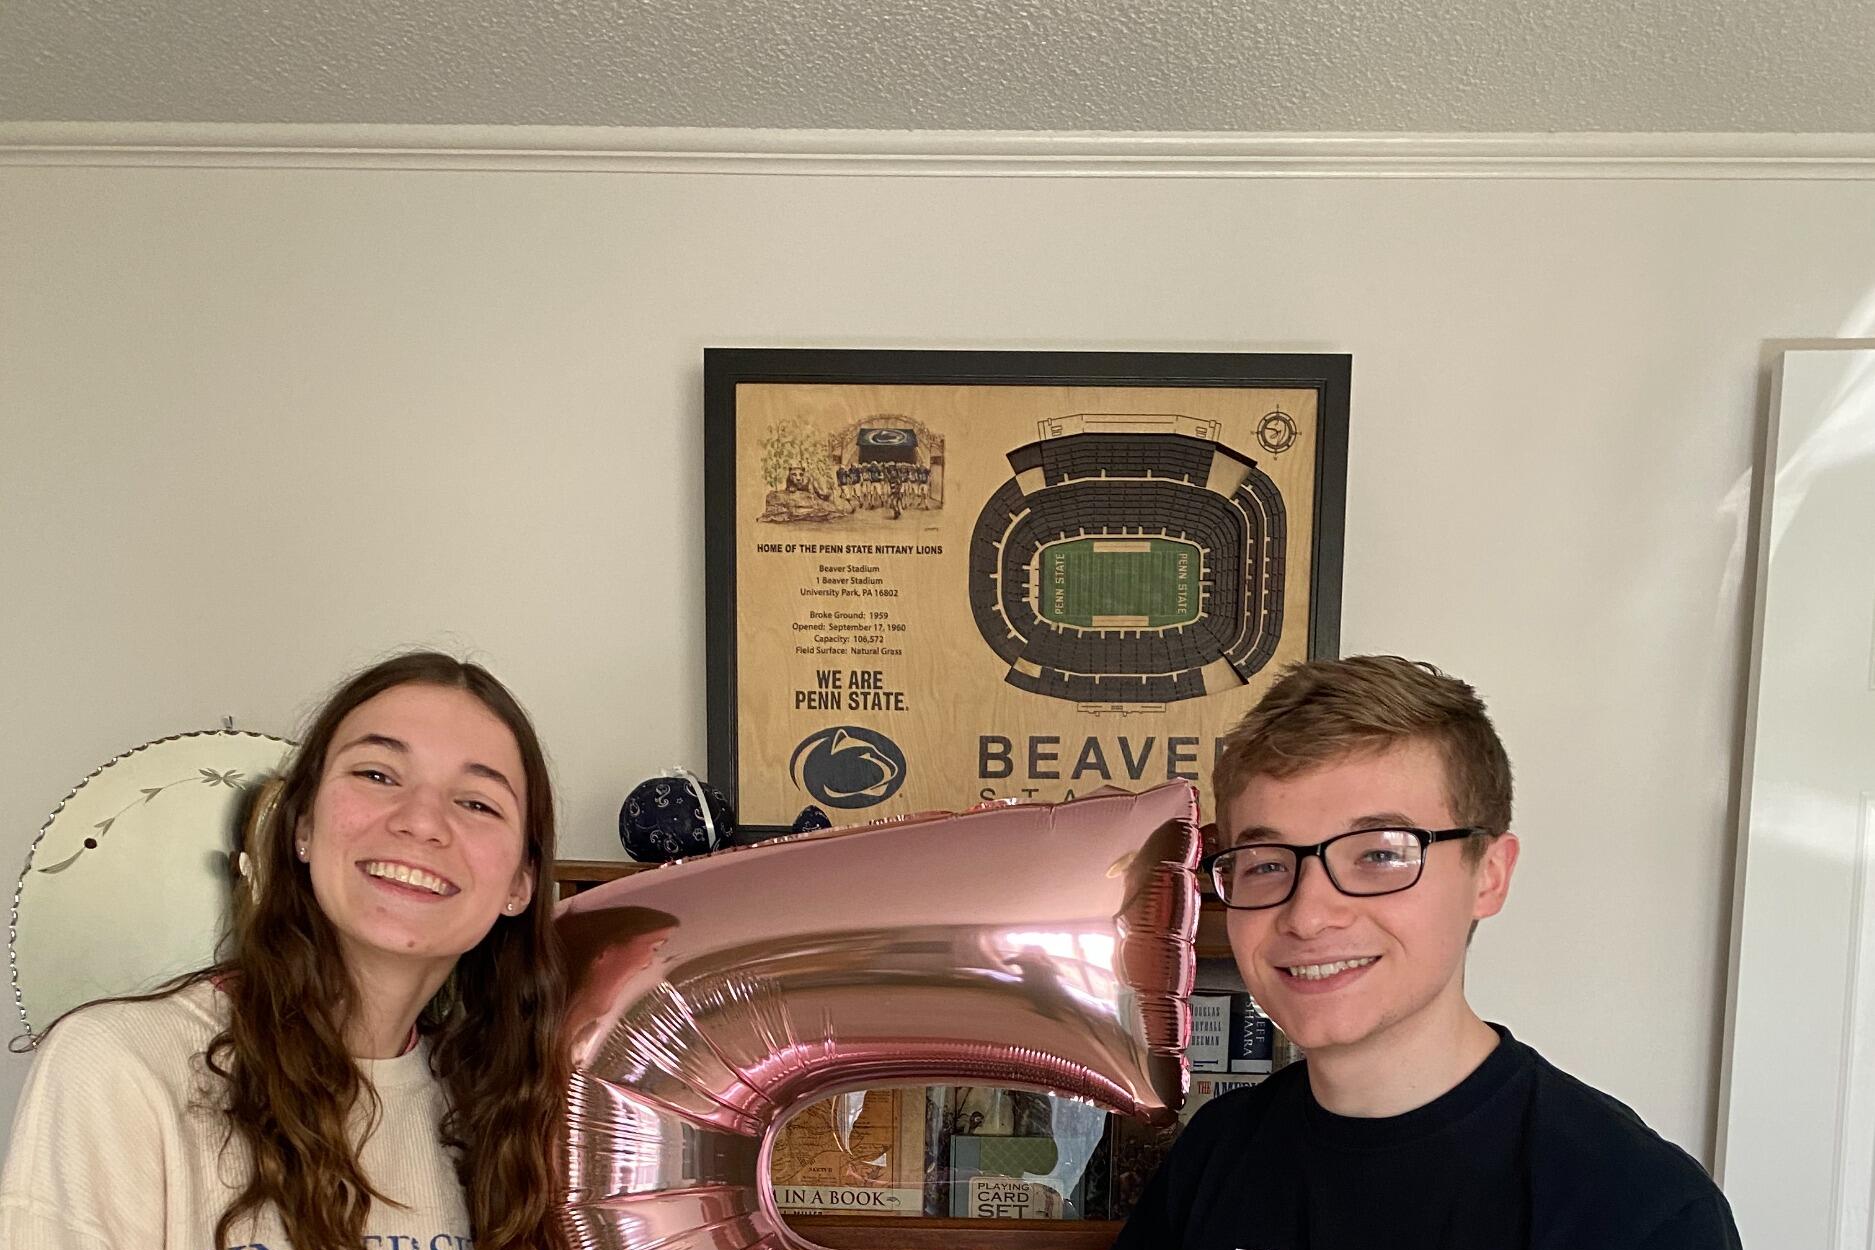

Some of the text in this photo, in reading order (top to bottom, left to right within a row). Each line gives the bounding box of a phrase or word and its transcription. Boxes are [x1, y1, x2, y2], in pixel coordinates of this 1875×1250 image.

[757, 544, 943, 555] HOME OF THE PENN STATE NITTANY LIONS
[819, 565, 880, 573] Beaver Stadium
[822, 577, 849, 585] Beaver
[850, 577, 883, 585] Stadium
[1055, 553, 1065, 615] PENN STATE
[1177, 553, 1188, 614] PENN STATE
[800, 589, 839, 598] University
[874, 589, 899, 598] 16802
[809, 611, 889, 620] Broke Ground: 1959
[792, 623, 906, 632] Opened: September 17, 1960
[814, 635, 884, 644] Capacity: 106,572
[795, 646, 902, 656] Field Surface: Natural Grass
[816, 669, 883, 690] WE ARE
[795, 691, 842, 710] PENN
[1243, 1001, 1255, 1056] SHAARA
[1198, 1081, 1212, 1094] THE
[977, 1182, 1030, 1191] PLAYING
[785, 1189, 805, 1204] IN
[811, 1190, 824, 1204] A
[829, 1190, 886, 1206] BOOK
[977, 1191, 1029, 1202] CARD
[977, 1203, 1029, 1218] SET
